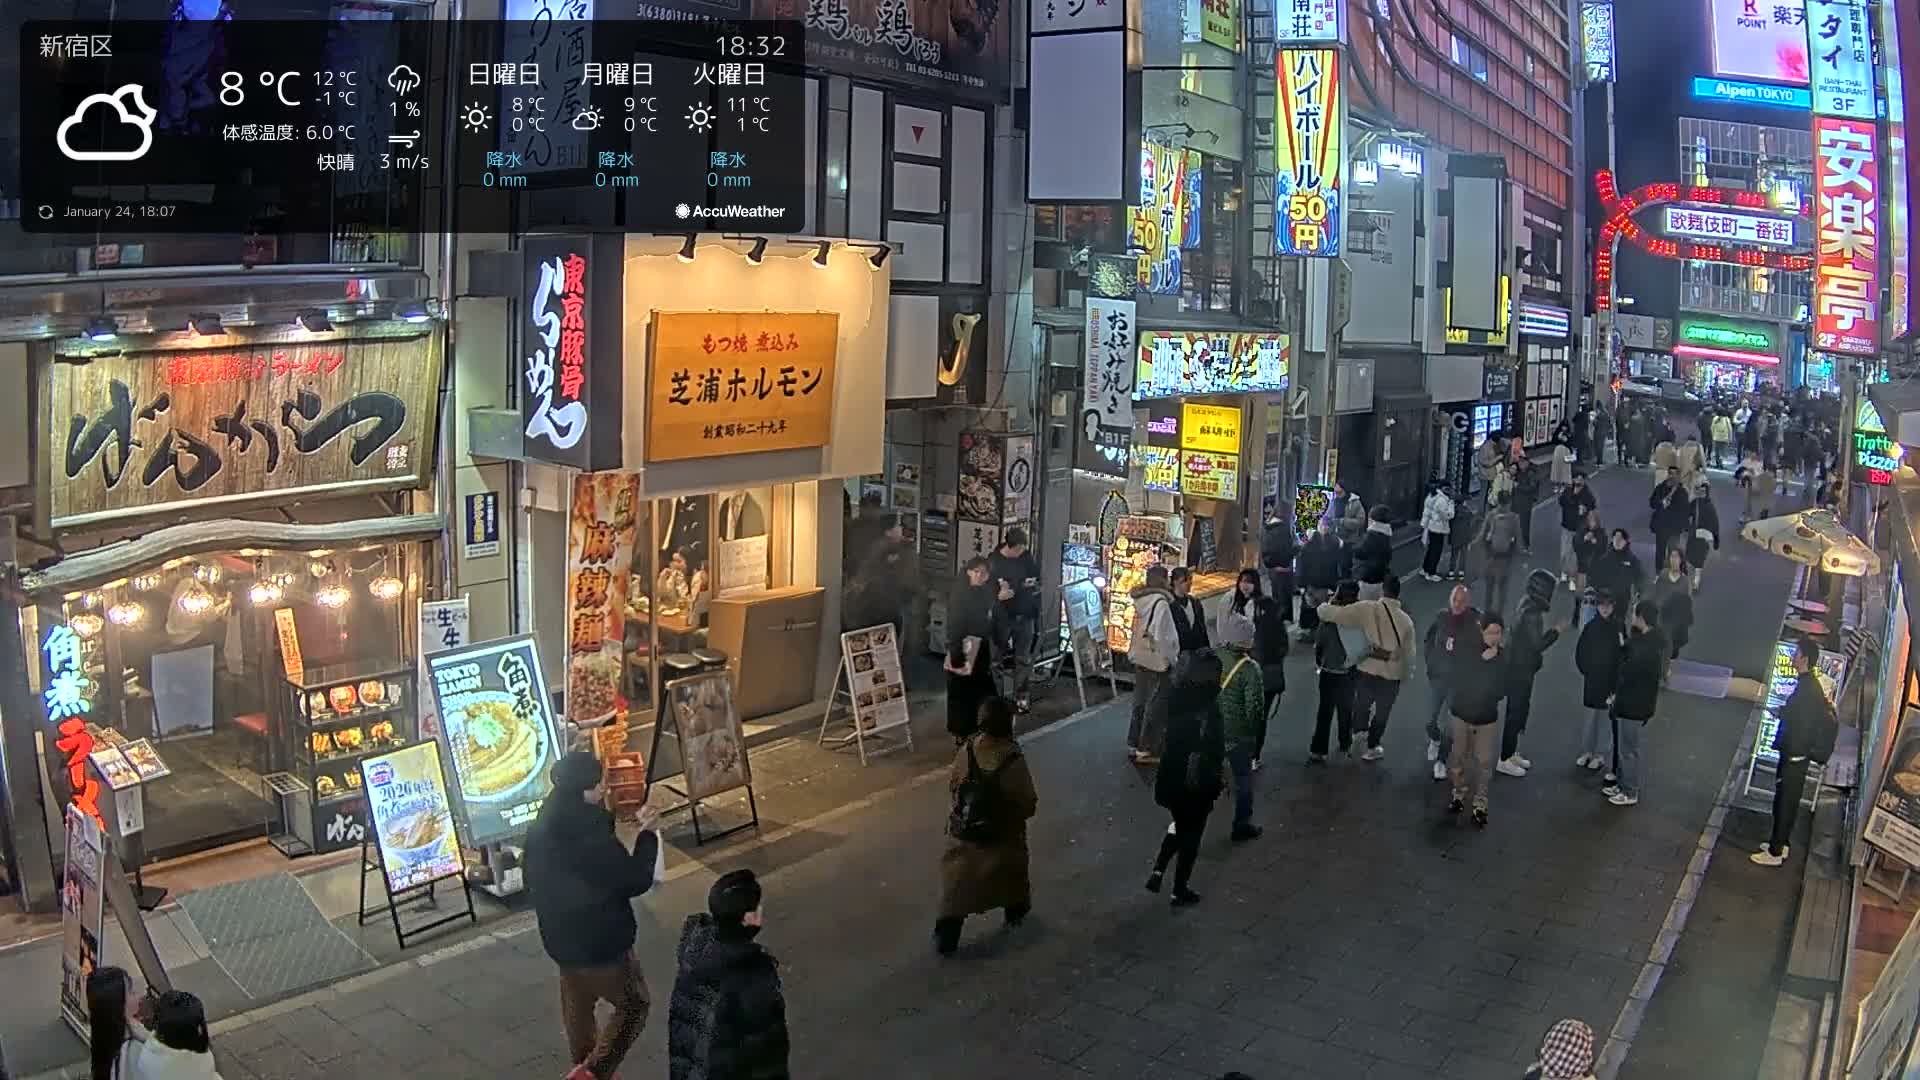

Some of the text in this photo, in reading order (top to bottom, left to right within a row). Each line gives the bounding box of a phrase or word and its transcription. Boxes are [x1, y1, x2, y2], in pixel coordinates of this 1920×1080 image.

[1737, 17, 1767, 31] POINT
[1589, 64, 1610, 79] 7F
[1716, 82, 1793, 101] Alpen TOKYO
[1832, 98, 1856, 111] 3F
[1294, 54, 1321, 190] ハイボール
[1161, 153, 1175, 288] ハイボール
[1669, 211, 1790, 243] 歌舞伎町一番街
[1820, 125, 1874, 331] 安楽亭
[559, 253, 586, 399] 東京豚骨
[701, 331, 800, 354] もつ焼 煮込み
[1817, 332, 1837, 348] 2F
[1102, 311, 1131, 414] お好み焼き
[668, 365, 823, 406] 芝浦ホルモン
[704, 418, 788, 440] 創業昭和二十九年
[1105, 431, 1130, 446] B1F
[435, 663, 480, 683] TOKYO
[438, 675, 483, 696] RAMEN
[500, 653, 540, 719] 角煮
